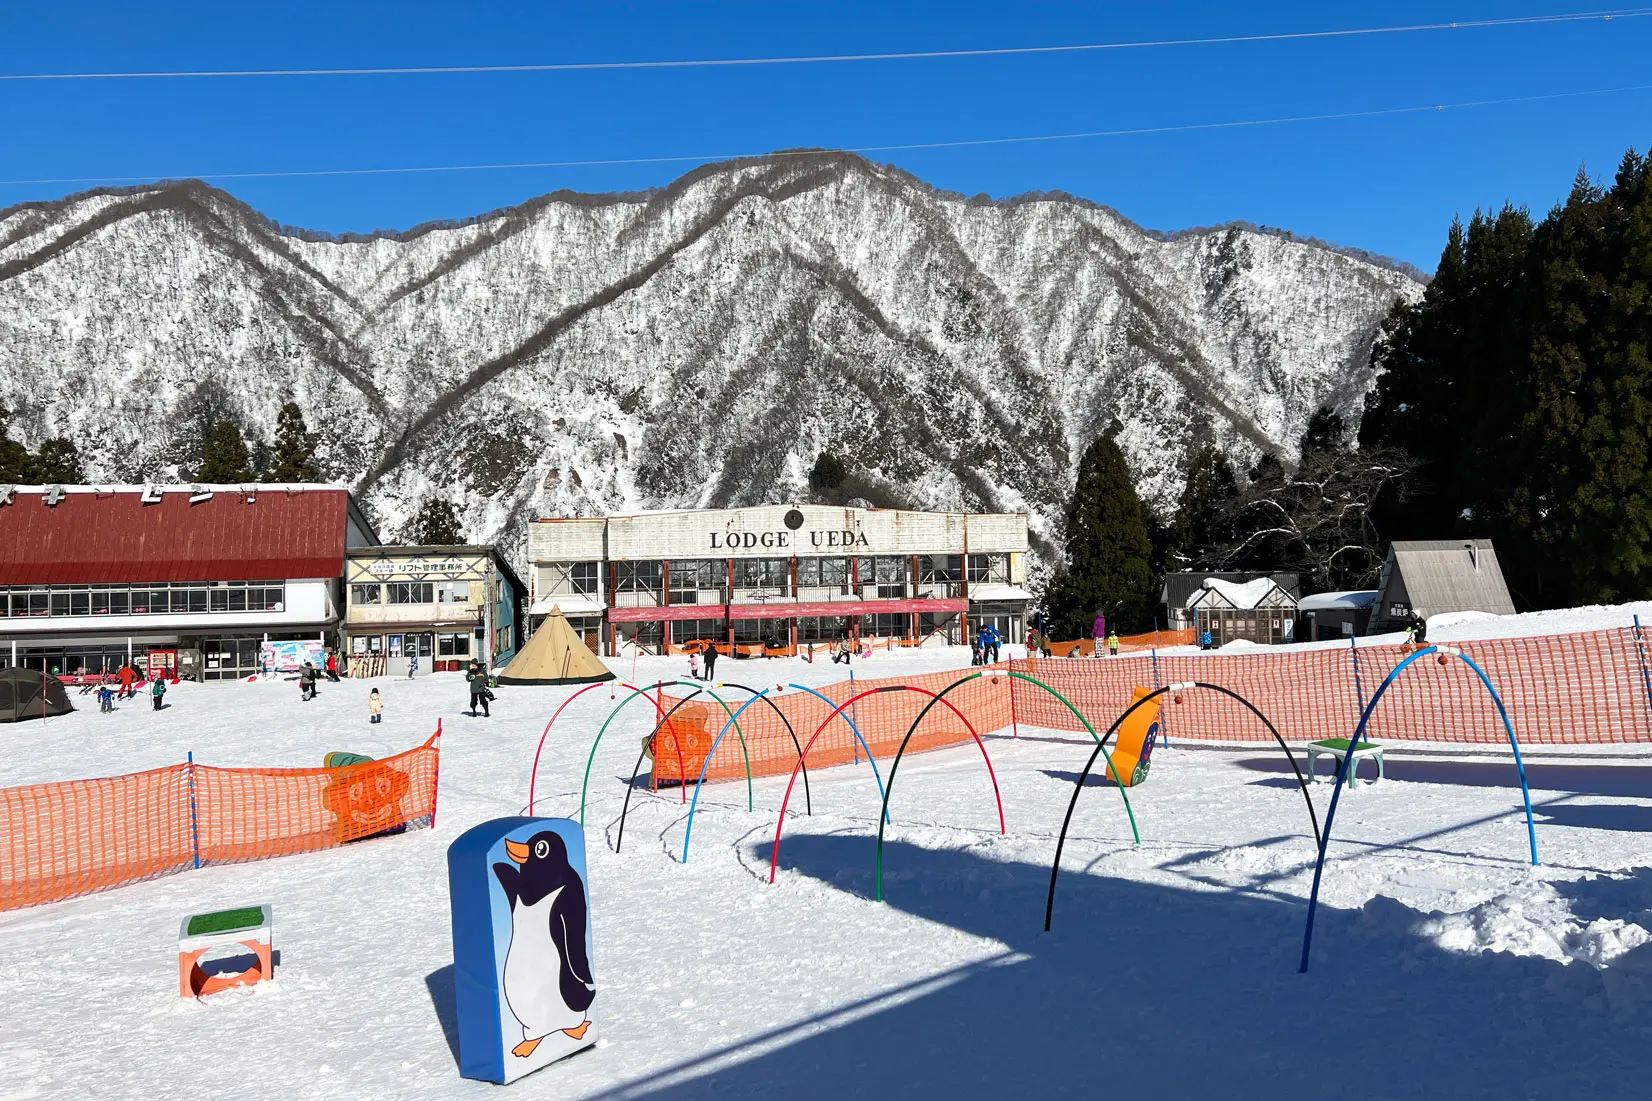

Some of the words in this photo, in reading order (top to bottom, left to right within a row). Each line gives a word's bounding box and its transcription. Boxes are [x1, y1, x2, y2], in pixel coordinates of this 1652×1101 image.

[709, 531, 789, 548] LODGE
[810, 530, 869, 547] UEDA
[398, 563, 463, 572] リフト管理事務所
